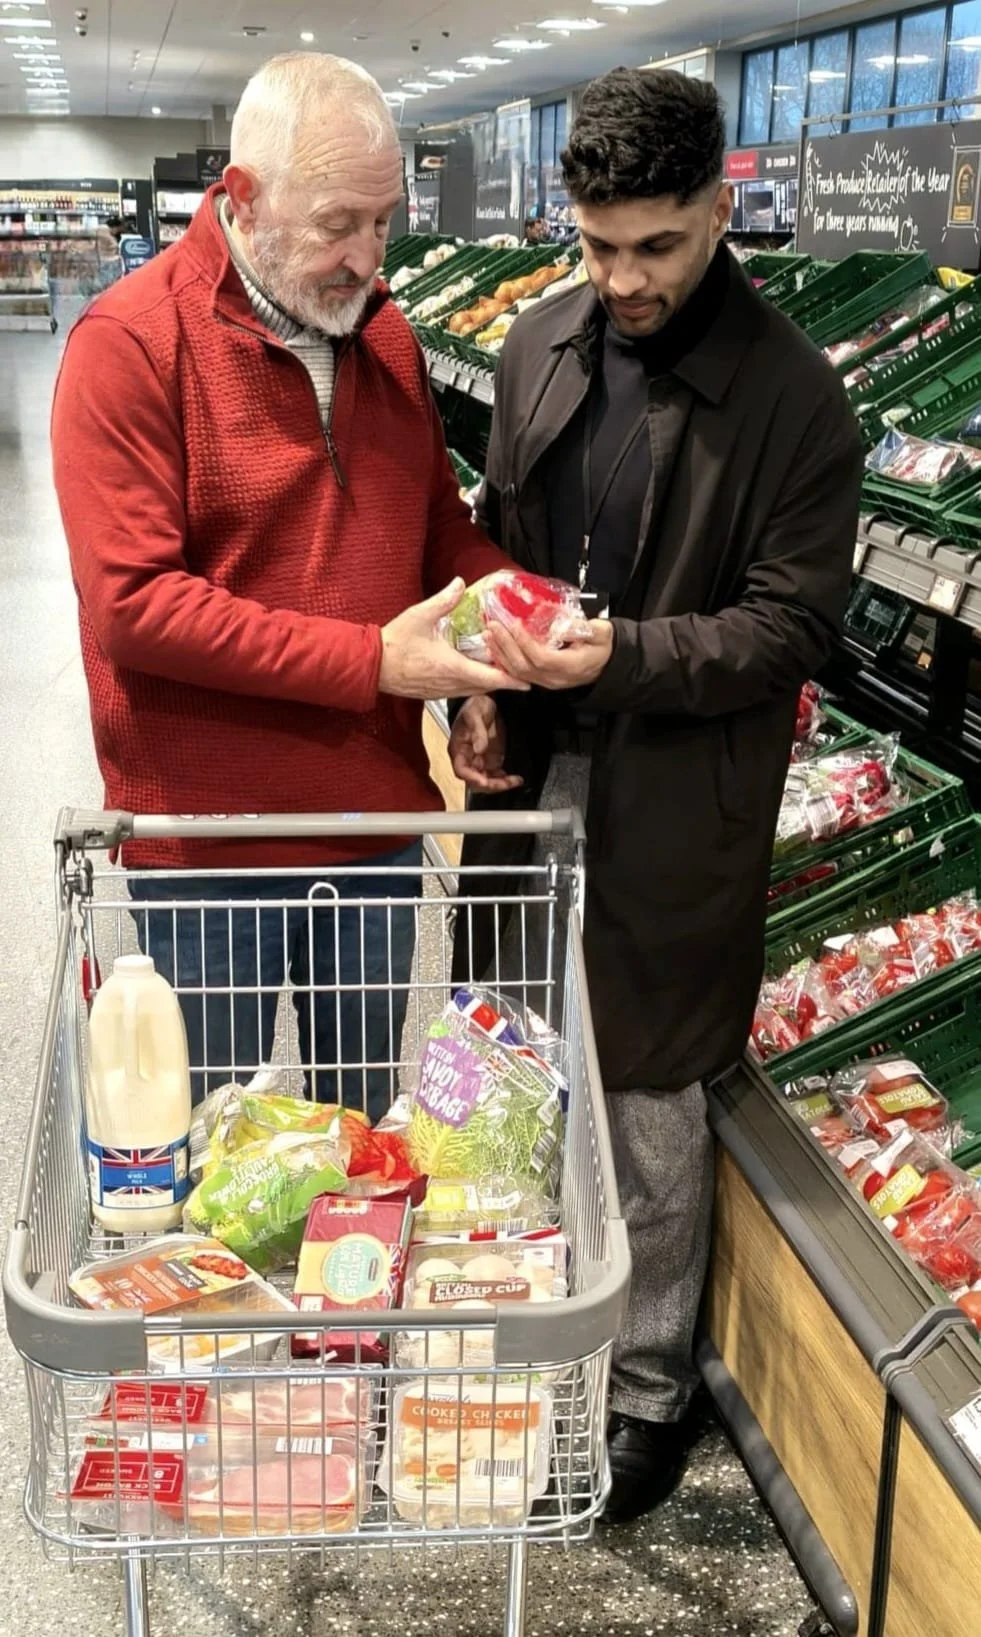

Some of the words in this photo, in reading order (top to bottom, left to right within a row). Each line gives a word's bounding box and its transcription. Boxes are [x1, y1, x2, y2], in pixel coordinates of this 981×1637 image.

[816, 170, 835, 195] Fresh
[836, 169, 865, 195] Produce
[867, 169, 898, 193] Retailer
[899, 165, 911, 197] of
[911, 165, 926, 193] the
[928, 166, 950, 193] Year
[813, 206, 825, 235] for
[826, 207, 844, 232] three
[845, 214, 867, 238] years
[868, 212, 899, 239] running
[435, 1286, 492, 1296] CLOSED
[495, 1284, 527, 1294] CUP
